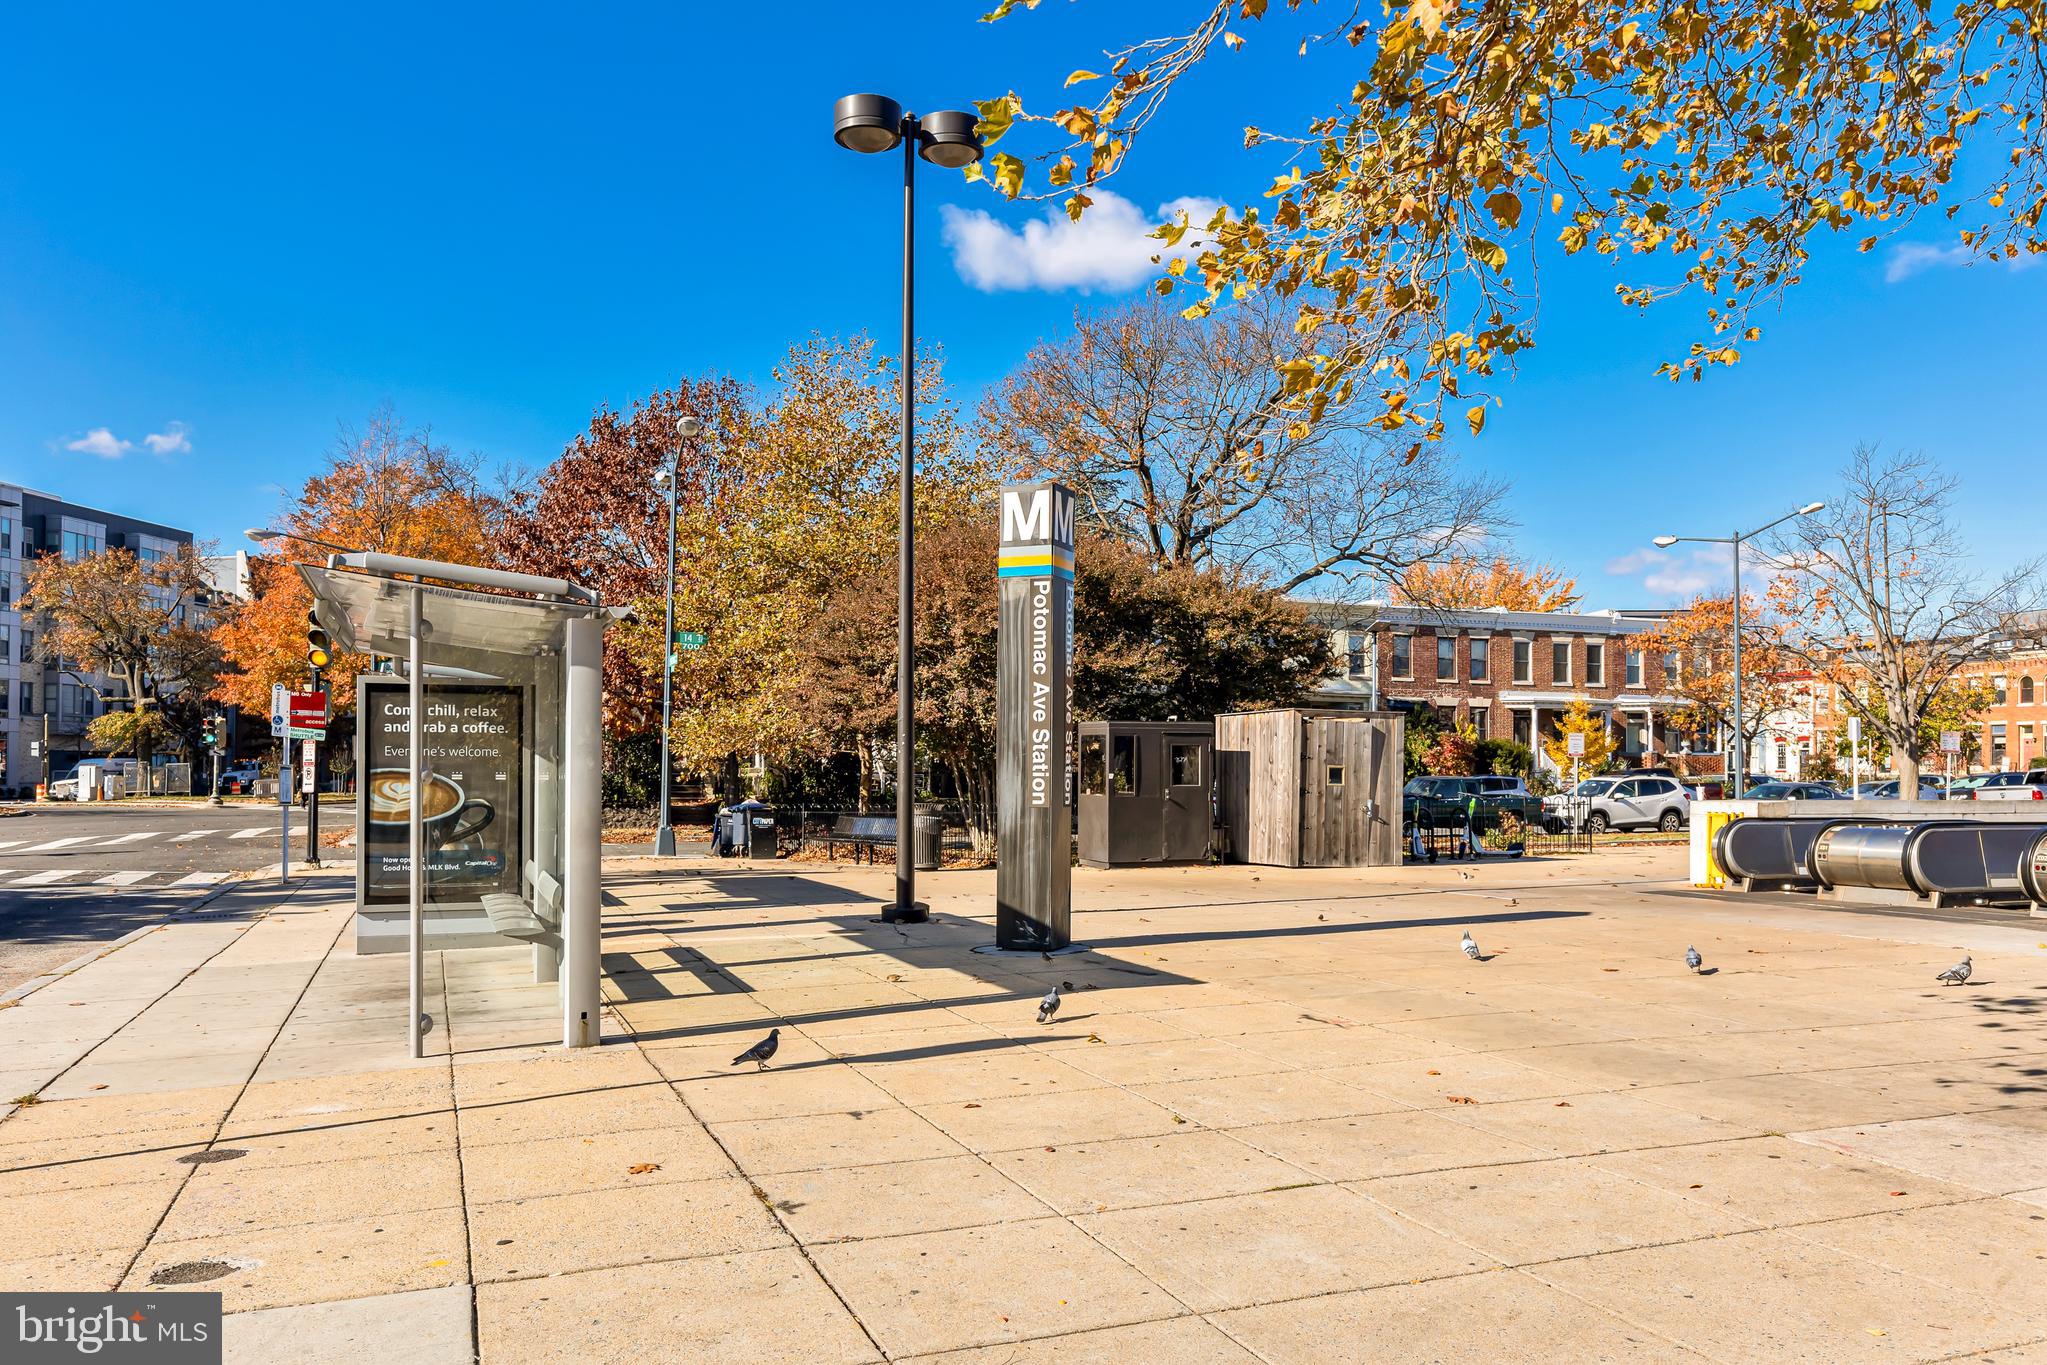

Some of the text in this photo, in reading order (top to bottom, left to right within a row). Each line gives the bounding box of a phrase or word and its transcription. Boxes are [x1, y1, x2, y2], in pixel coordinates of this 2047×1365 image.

[1003, 489, 1050, 542] M
[1054, 490, 1074, 546] M
[1032, 580, 1050, 805] Potomac Ave Station
[1064, 585, 1074, 805] Potomac Ave Station
[384, 720, 411, 733] and
[450, 723, 458, 733] a
[462, 721, 508, 734] coffee.
[427, 703, 460, 719] chill,
[463, 705, 498, 717] relax
[384, 745, 502, 757] Everne's welcome.
[444, 863, 460, 871] Blvd.
